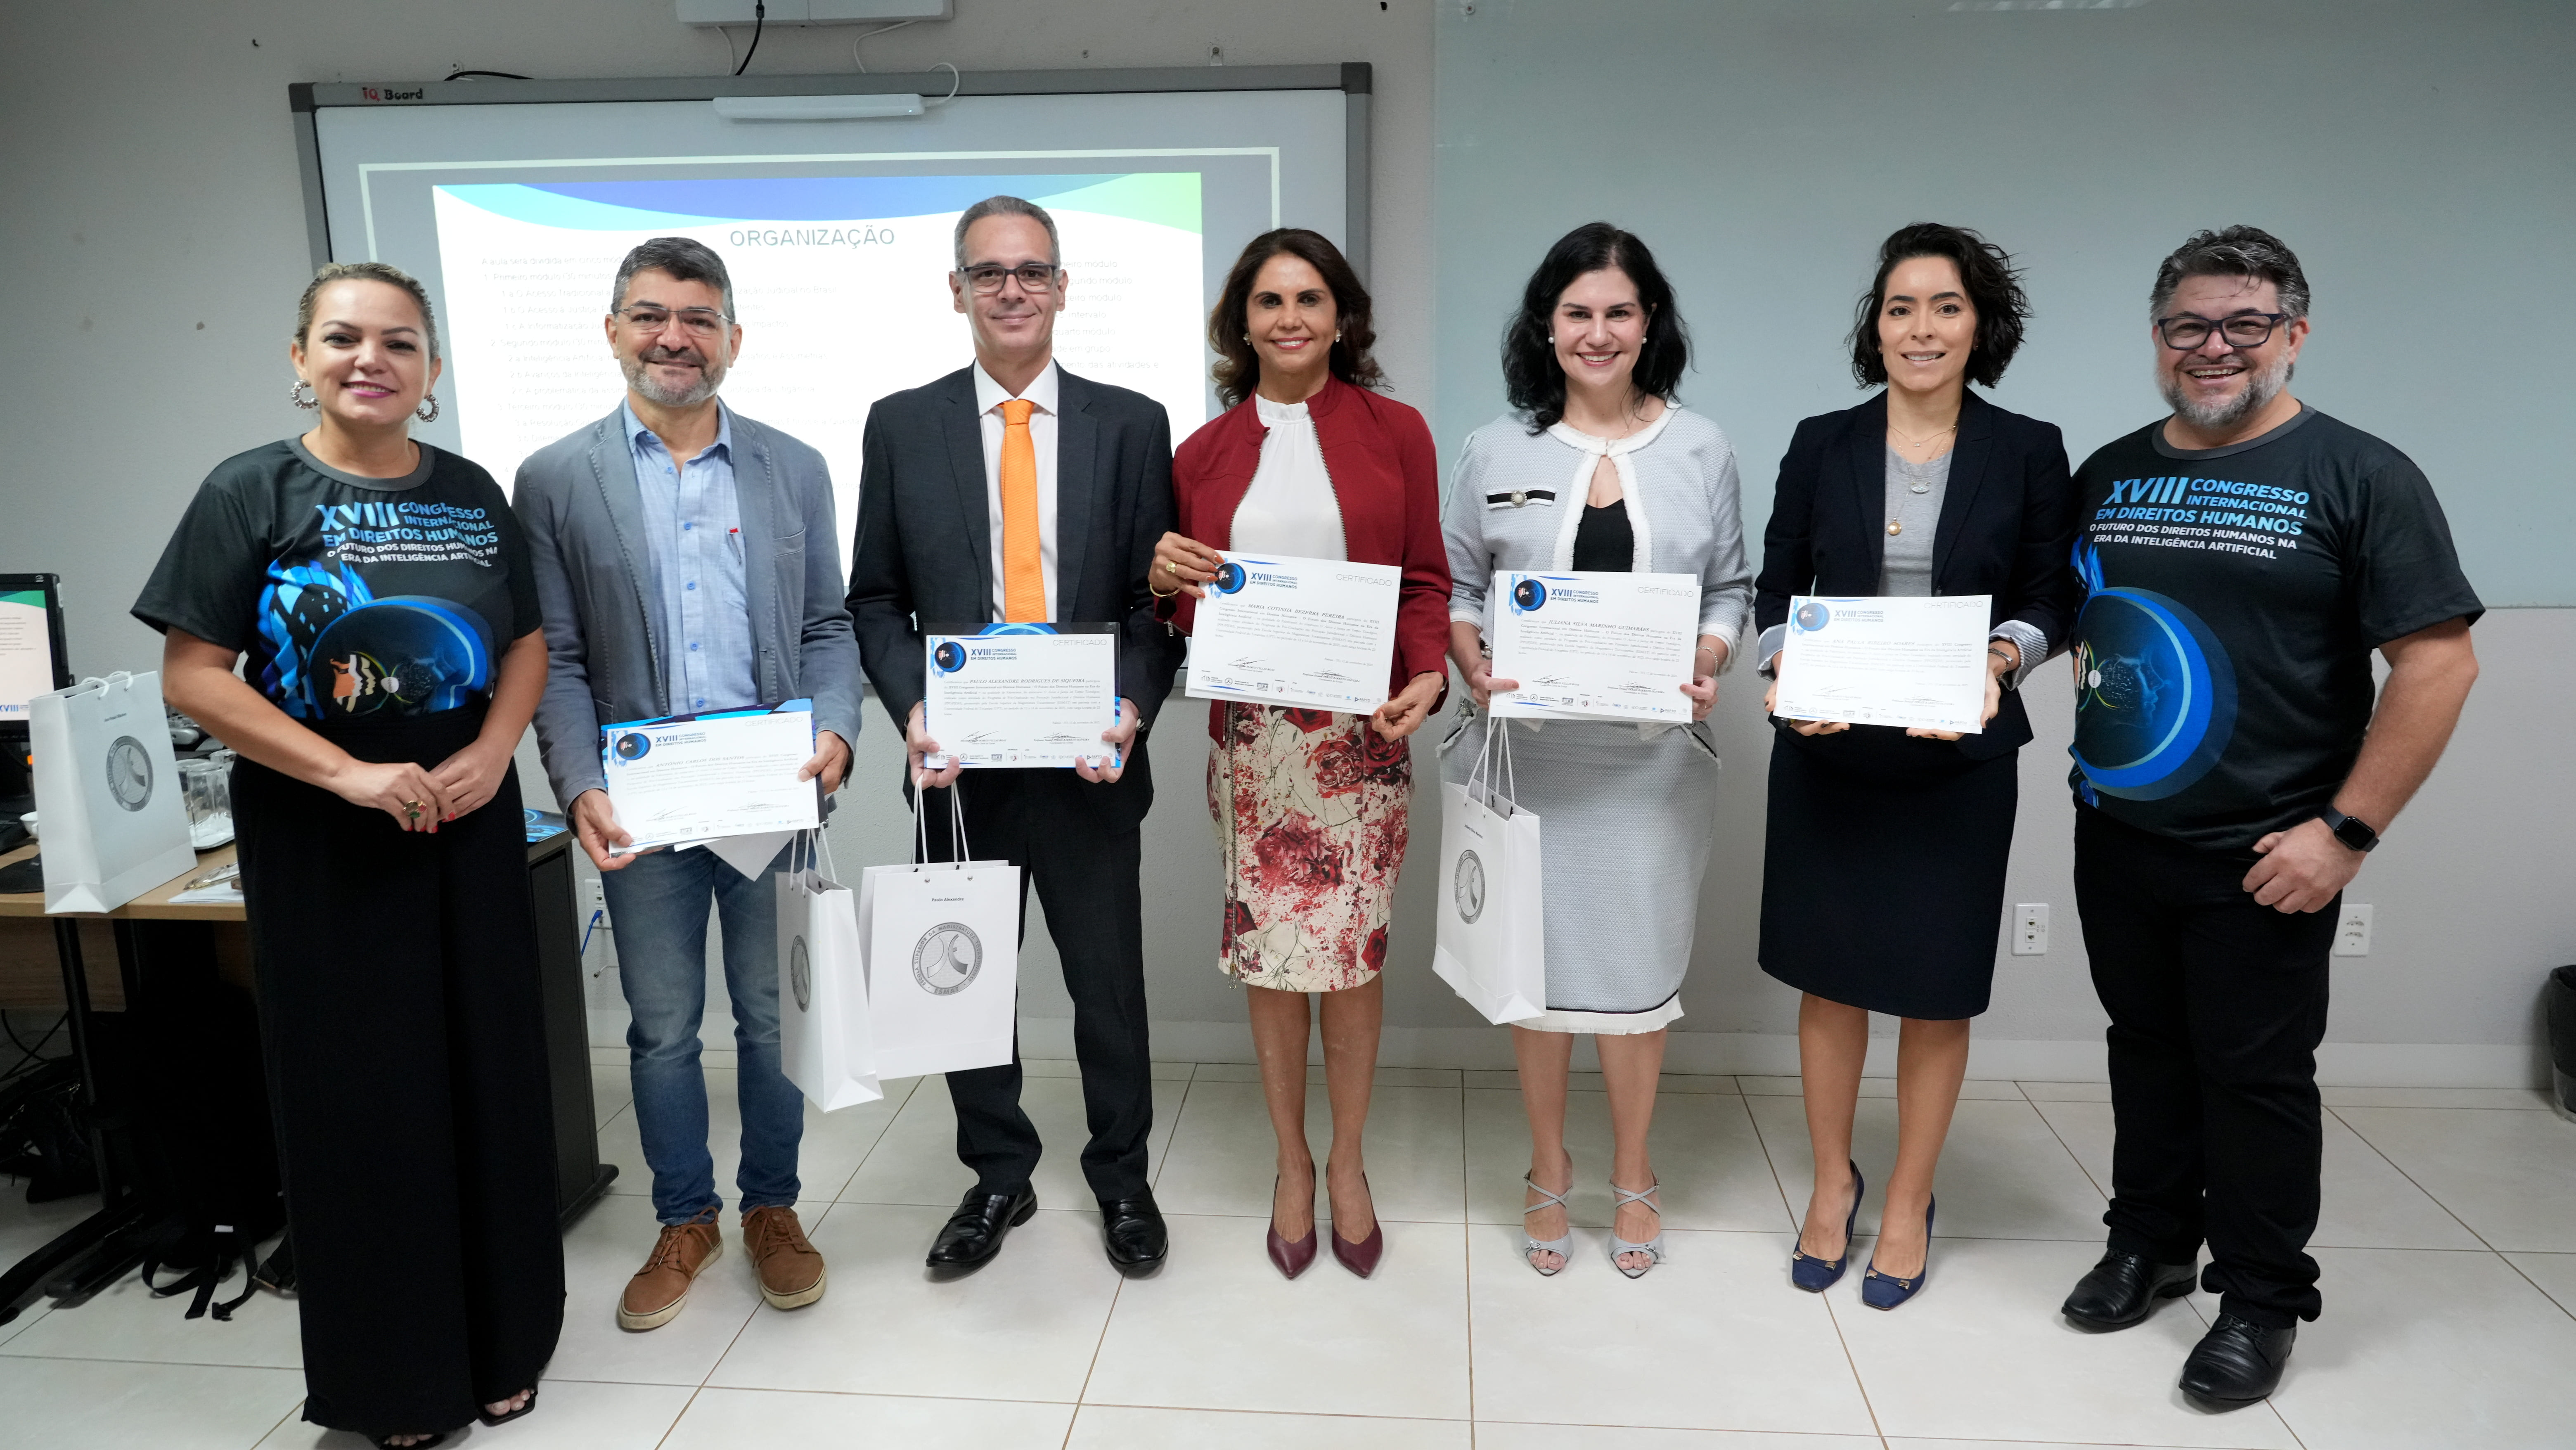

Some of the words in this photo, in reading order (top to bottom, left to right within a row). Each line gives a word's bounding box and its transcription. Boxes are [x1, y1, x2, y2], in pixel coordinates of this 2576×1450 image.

[384, 88, 423, 100] Board
[730, 225, 895, 249] ORGANIZAÇÃO
[814, 286, 837, 294] Brasil
[500, 339, 538, 348] Segundo
[523, 354, 570, 363] Inteligência
[535, 387, 586, 396] problemática
[2102, 476, 2189, 506] XVIII
[2190, 478, 2309, 505] CONGRESSO
[2186, 495, 2308, 519] INTERNACIONAL
[315, 501, 400, 531] XVIII
[2094, 508, 2115, 520] EM
[2117, 507, 2197, 524] DIREITOS
[2199, 511, 2303, 536] HUMANOS
[322, 534, 346, 547] EM
[348, 527, 423, 543] DIREITOS
[2089, 524, 2096, 532] O
[2096, 523, 2135, 532] FUTURO
[2138, 524, 2159, 533] DOS
[2161, 526, 2211, 537] DIREITOS
[2212, 528, 2275, 546] HUMANOS
[2279, 538, 2297, 550] NA
[336, 543, 375, 554] FUTURO
[376, 543, 399, 552] DOS
[401, 543, 445, 552] DIREITOS
[2093, 534, 2112, 543] ERA
[2114, 535, 2129, 543] DA
[2131, 535, 2206, 550] INTELIGÊNCIA
[2207, 541, 2277, 560] ARTIFICIAL
[341, 553, 362, 564] ERA
[363, 553, 379, 564] DA
[380, 552, 449, 563] INTELIGÊNCIA
[1251, 572, 1272, 582] XVIII
[1336, 573, 1392, 587] CERTIFICADO
[1551, 588, 1572, 597] XVIII
[1638, 586, 1694, 598] CERTIFICADO
[1835, 609, 1856, 618] XVIII
[1618, 624, 1650, 632] GUIMARÃES
[745, 716, 803, 728] CERTIFICADO
[655, 734, 678, 744] XVIII
[938, 924, 976, 940] MAGISTRATURA
[914, 937, 928, 964] SUPERIOR
[914, 967, 926, 986] ESCOLA
[933, 987, 960, 995] ESMAT
